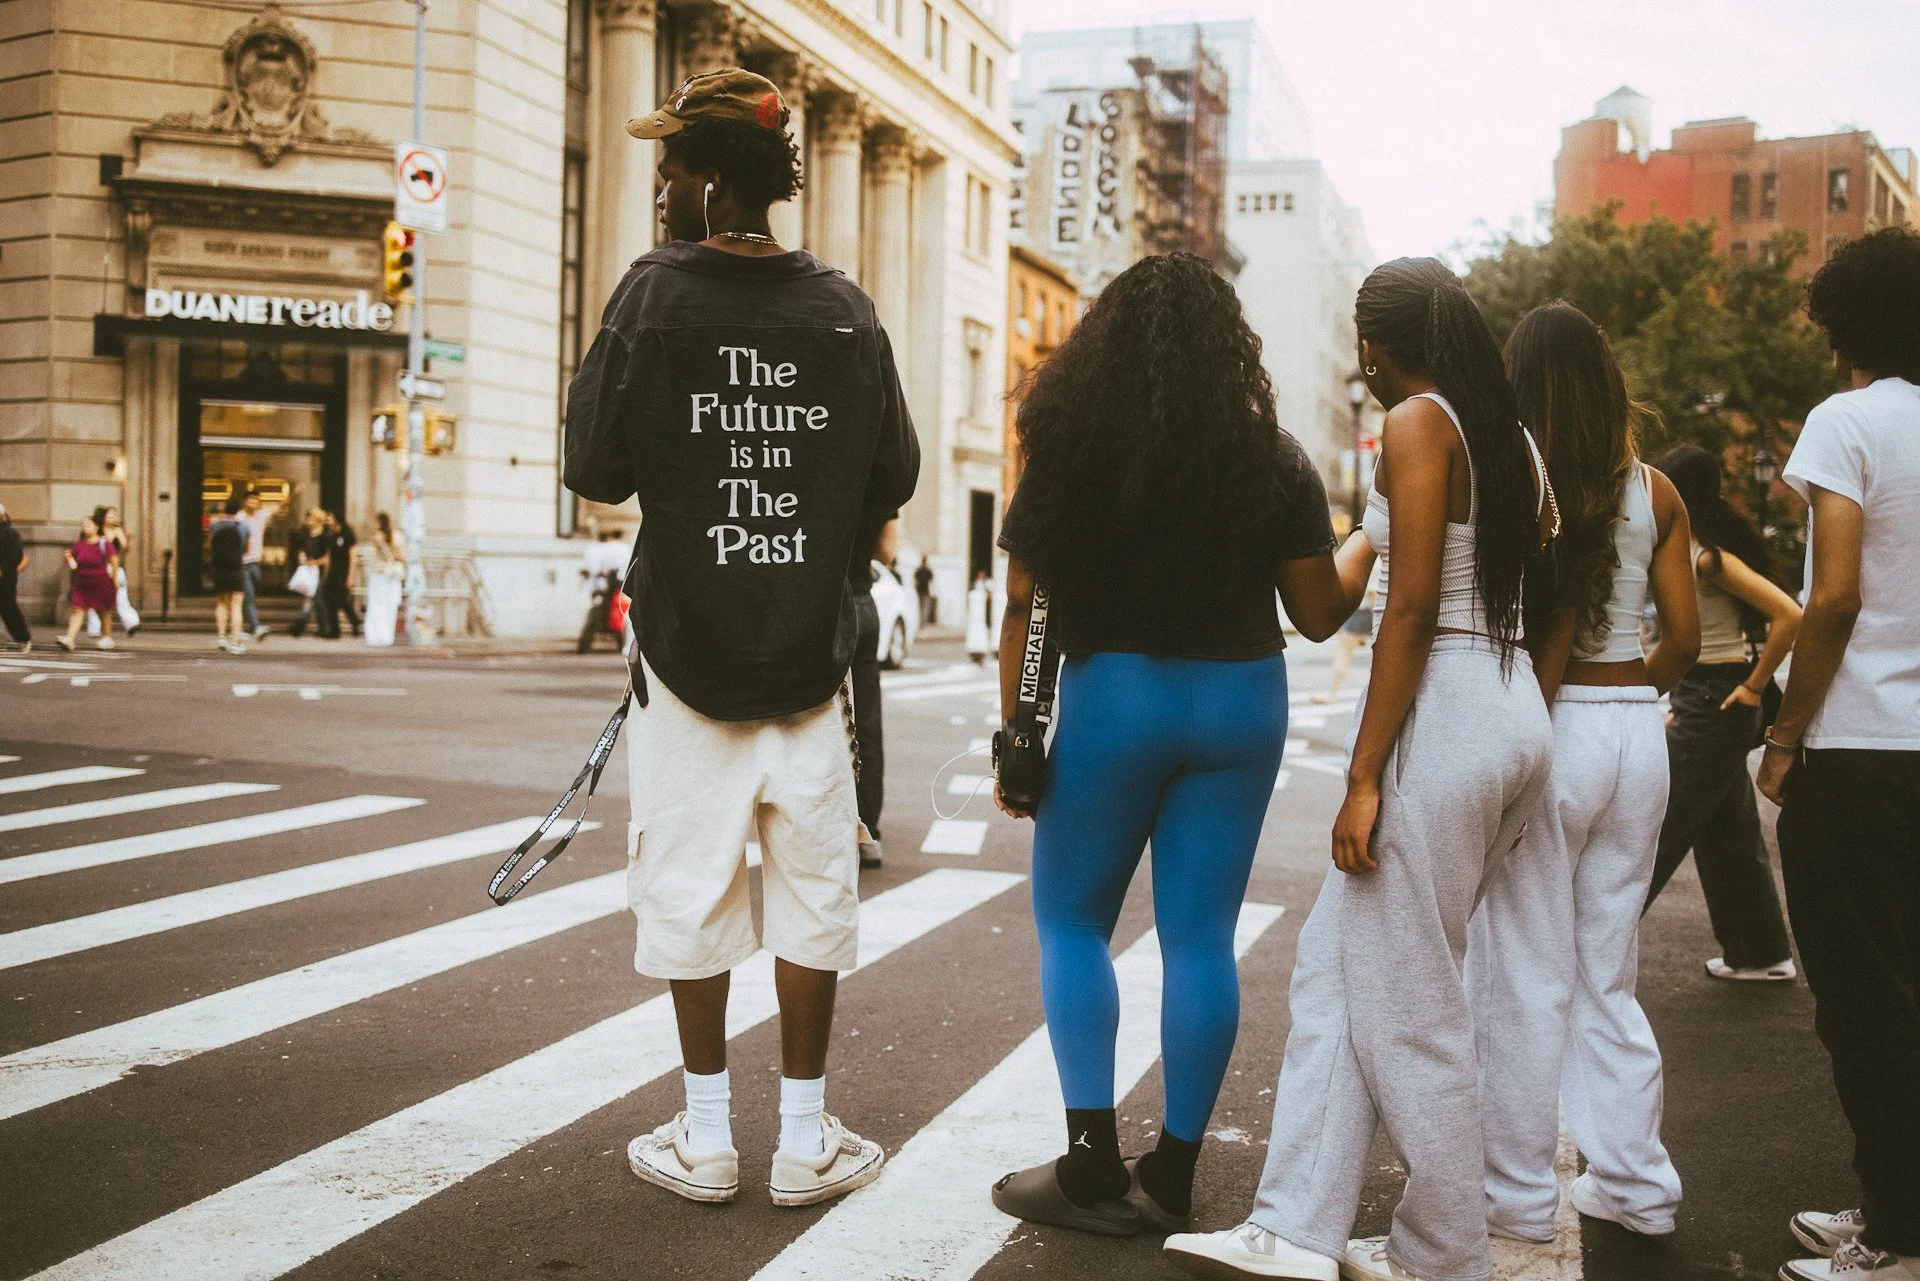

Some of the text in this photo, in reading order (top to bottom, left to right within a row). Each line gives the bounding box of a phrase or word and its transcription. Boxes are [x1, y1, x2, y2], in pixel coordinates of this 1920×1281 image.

[718, 346, 798, 388] The
[690, 393, 829, 433] Future
[730, 439, 792, 468] is in
[718, 478, 799, 518] The
[706, 524, 807, 565] Past
[1022, 616, 1045, 697] MICHAEL
[588, 735, 608, 765] TOURS
[540, 805, 562, 833] TOURS
[488, 868, 508, 896] TOURS
[520, 857, 548, 884] TOURS
